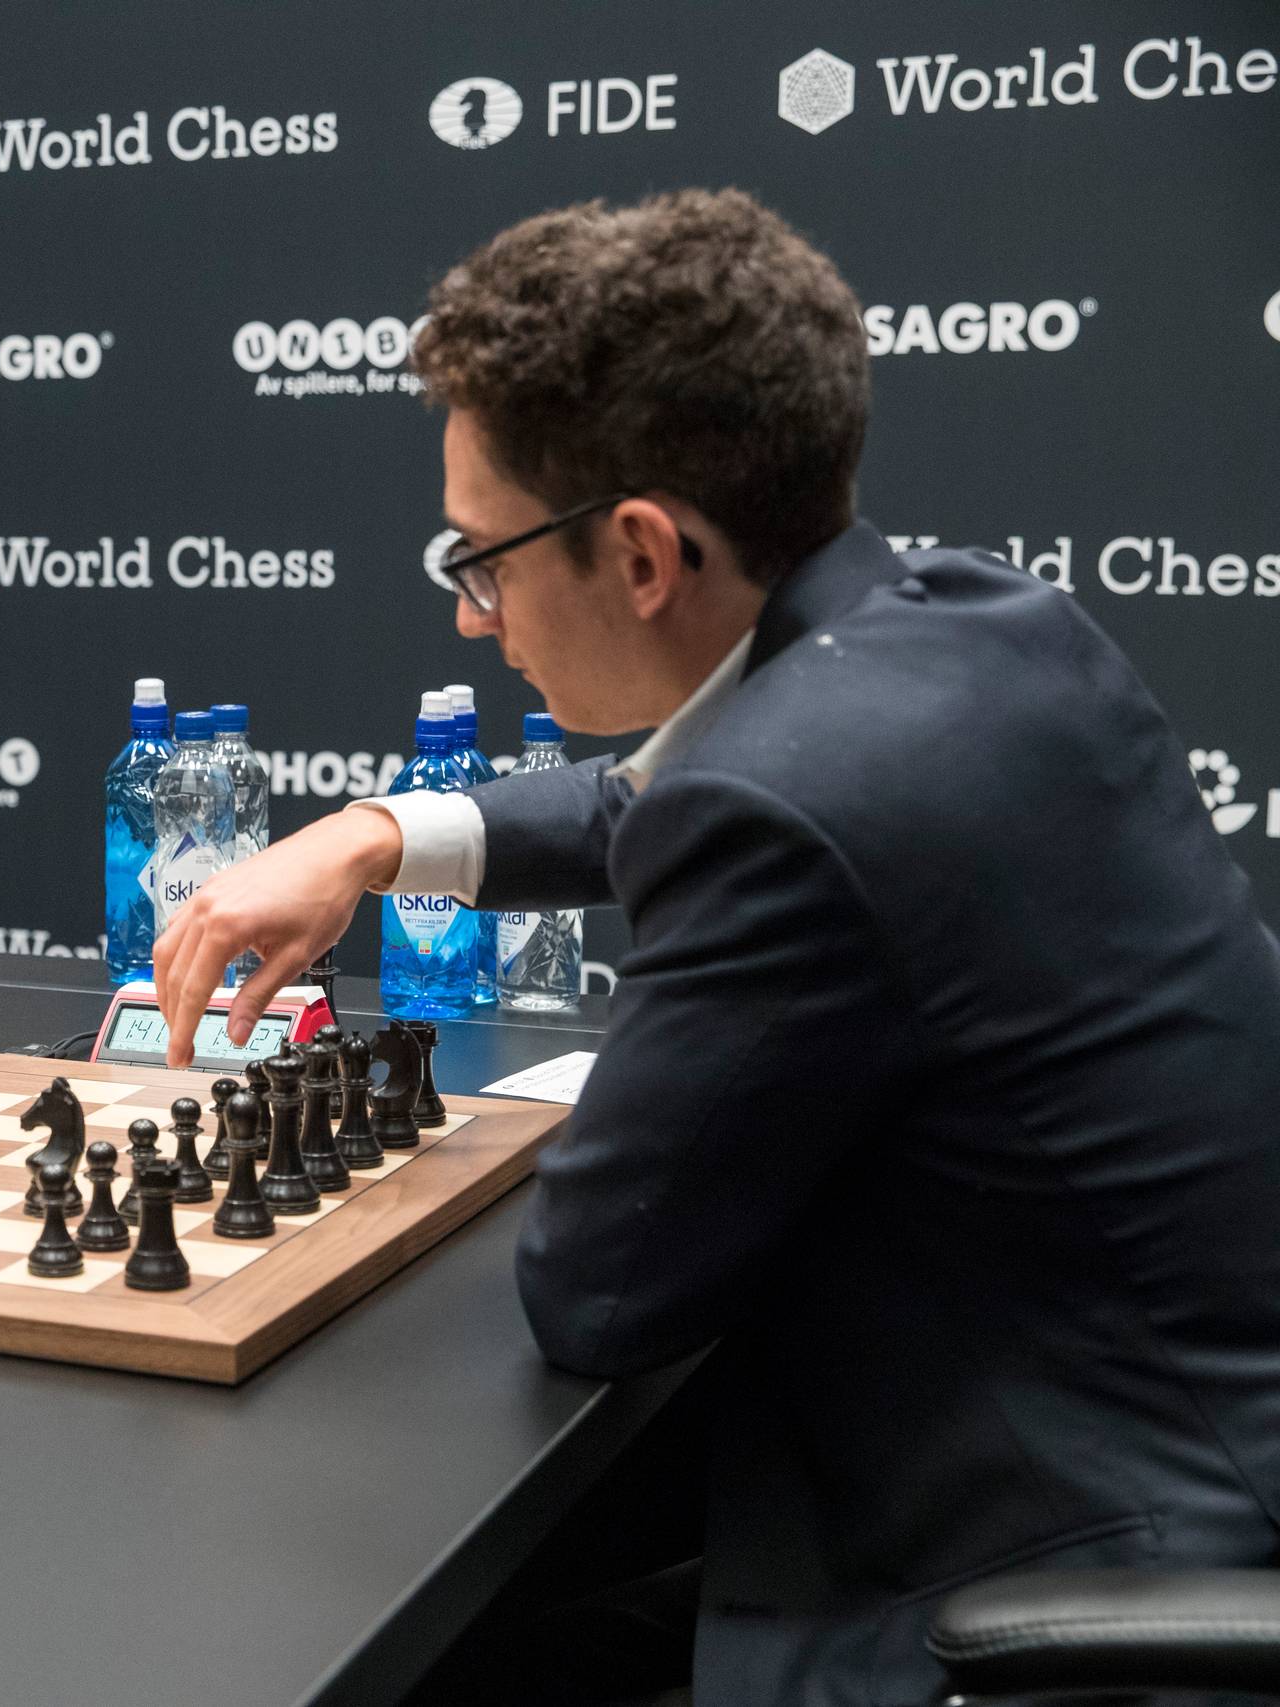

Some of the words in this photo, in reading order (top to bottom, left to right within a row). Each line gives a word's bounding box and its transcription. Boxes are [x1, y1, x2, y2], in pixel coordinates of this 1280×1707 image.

[876, 43, 1099, 116] World
[1123, 36, 1279, 100] Che
[547, 73, 678, 137] FIDE
[166, 106, 339, 162] Chess
[234, 318, 408, 371] UNIB
[167, 535, 336, 589] Chess
[1098, 536, 1280, 597] Ches
[165, 880, 202, 902] iskl
